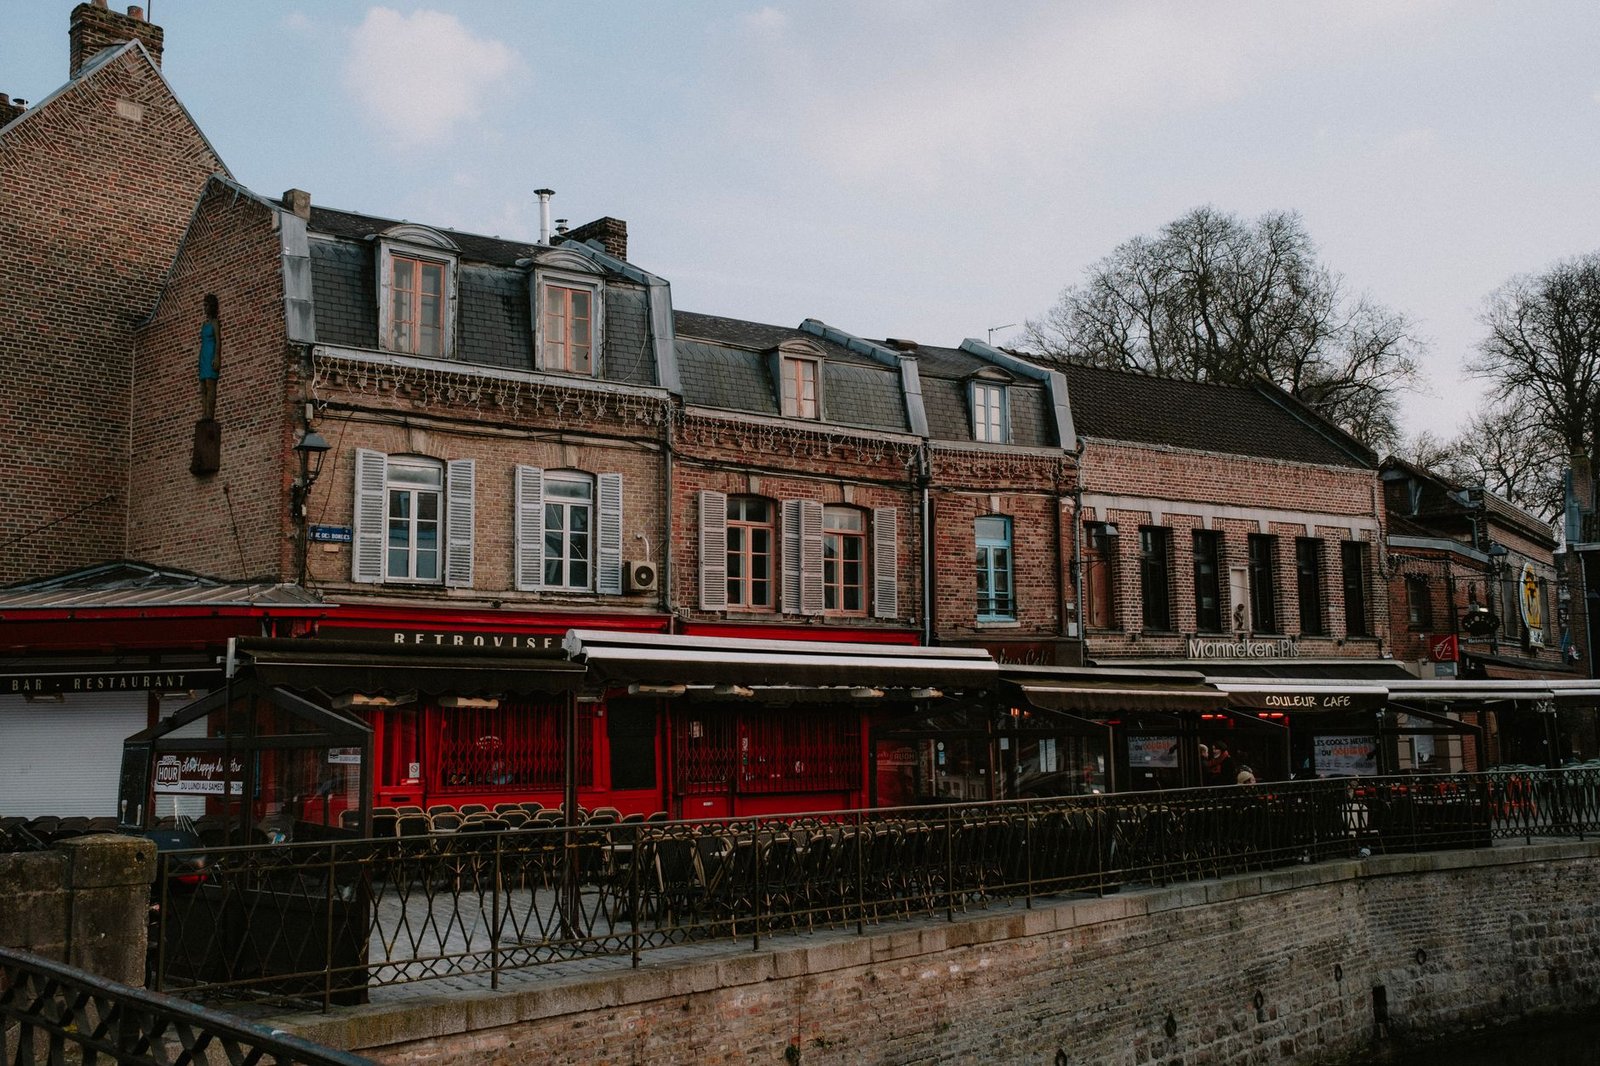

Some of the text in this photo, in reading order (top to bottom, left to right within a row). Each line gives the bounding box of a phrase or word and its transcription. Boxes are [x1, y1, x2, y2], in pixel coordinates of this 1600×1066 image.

[393, 632, 553, 649] RETROVISE
[11, 679, 42, 691] BAR
[73, 675, 186, 690] RESTAURANT
[1265, 695, 1351, 707] COULEUR CAFE
[159, 766, 178, 781] HOUR
